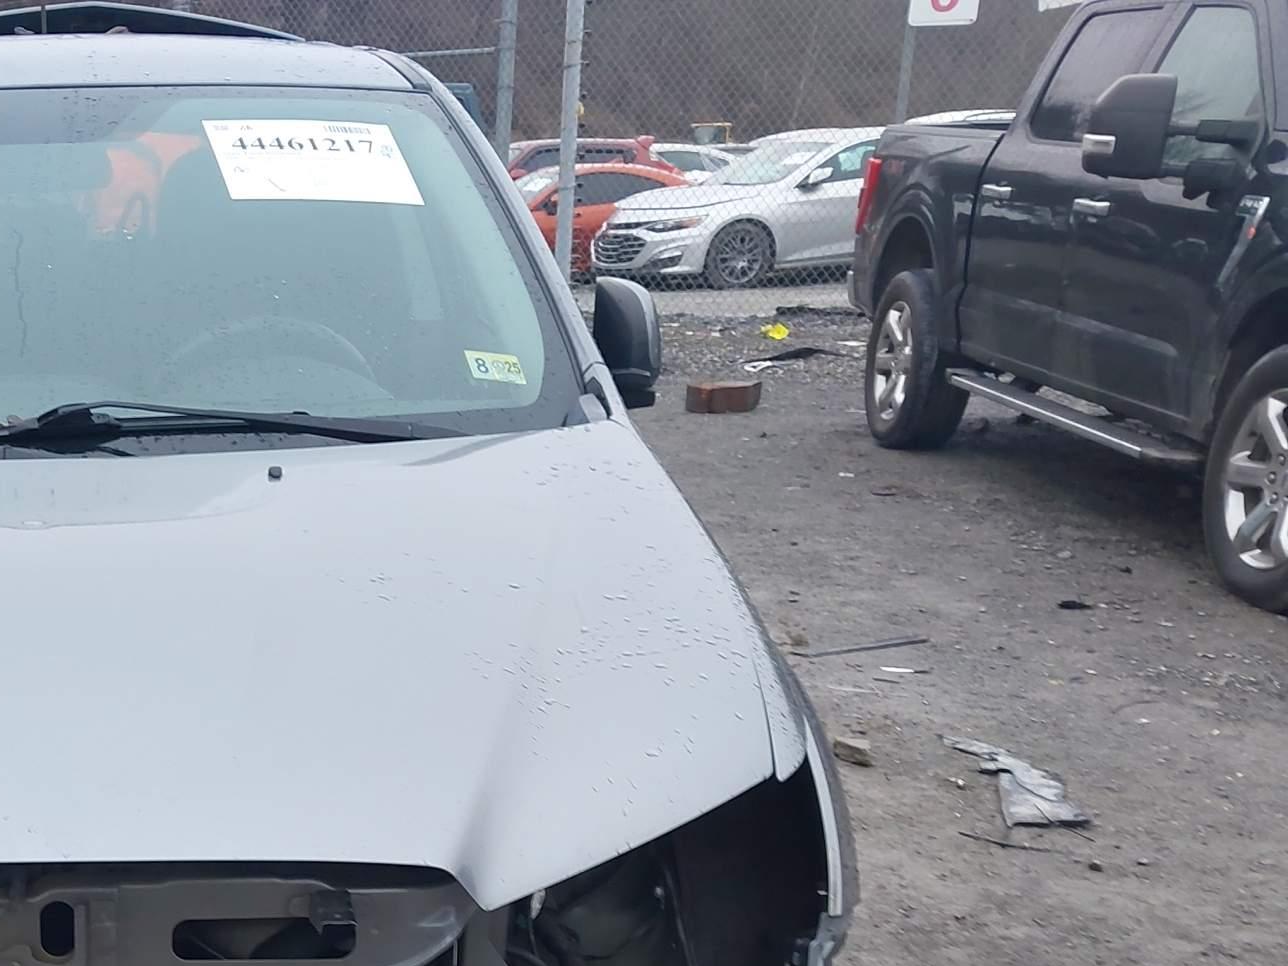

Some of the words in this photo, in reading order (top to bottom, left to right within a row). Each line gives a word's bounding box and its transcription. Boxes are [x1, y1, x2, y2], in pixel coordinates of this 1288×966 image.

[231, 135, 374, 154] 44461217
[474, 357, 490, 374] 8
[503, 360, 521, 375] 25
